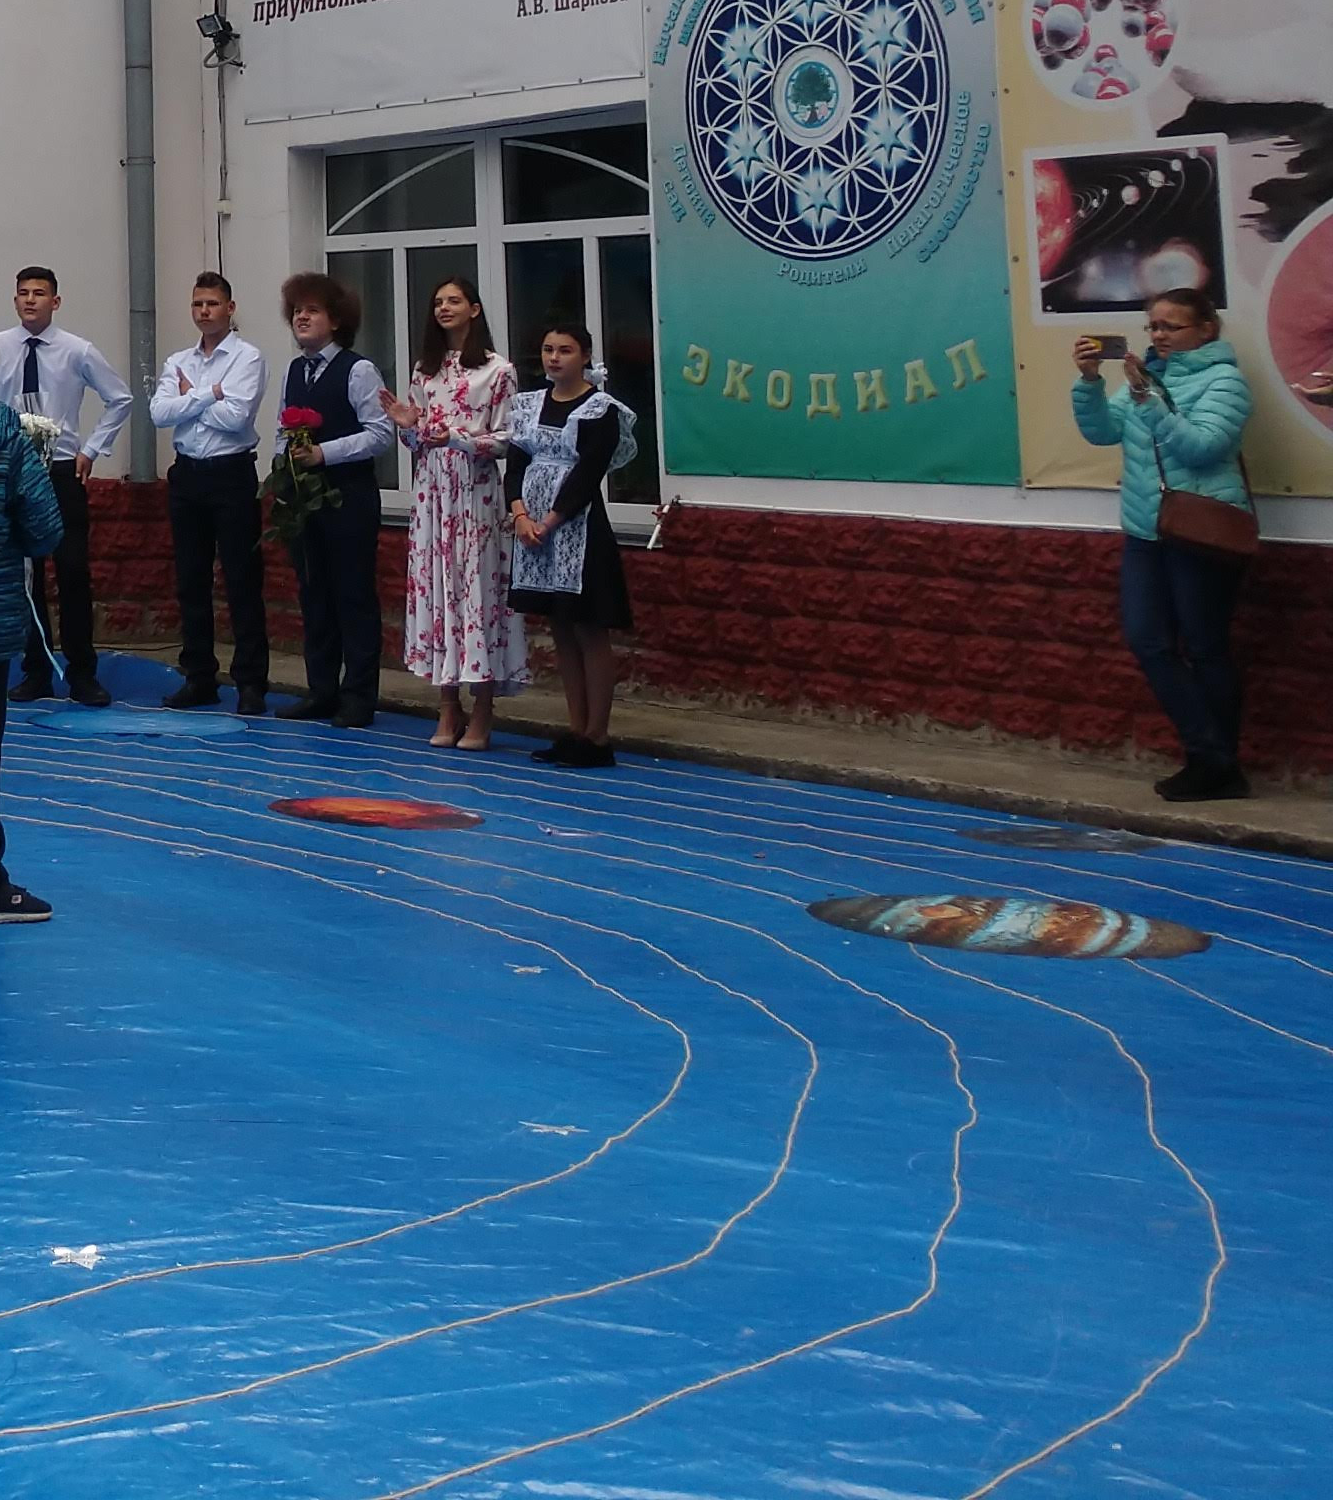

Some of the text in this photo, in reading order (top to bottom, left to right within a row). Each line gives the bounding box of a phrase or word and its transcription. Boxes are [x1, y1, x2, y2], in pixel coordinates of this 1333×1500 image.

[662, 180, 688, 224] сад
[884, 90, 971, 259] Педагогическое
[917, 123, 991, 264] сообщество
[776, 261, 868, 287] Родители
[683, 339, 987, 419] ЭКОДИАЛ
